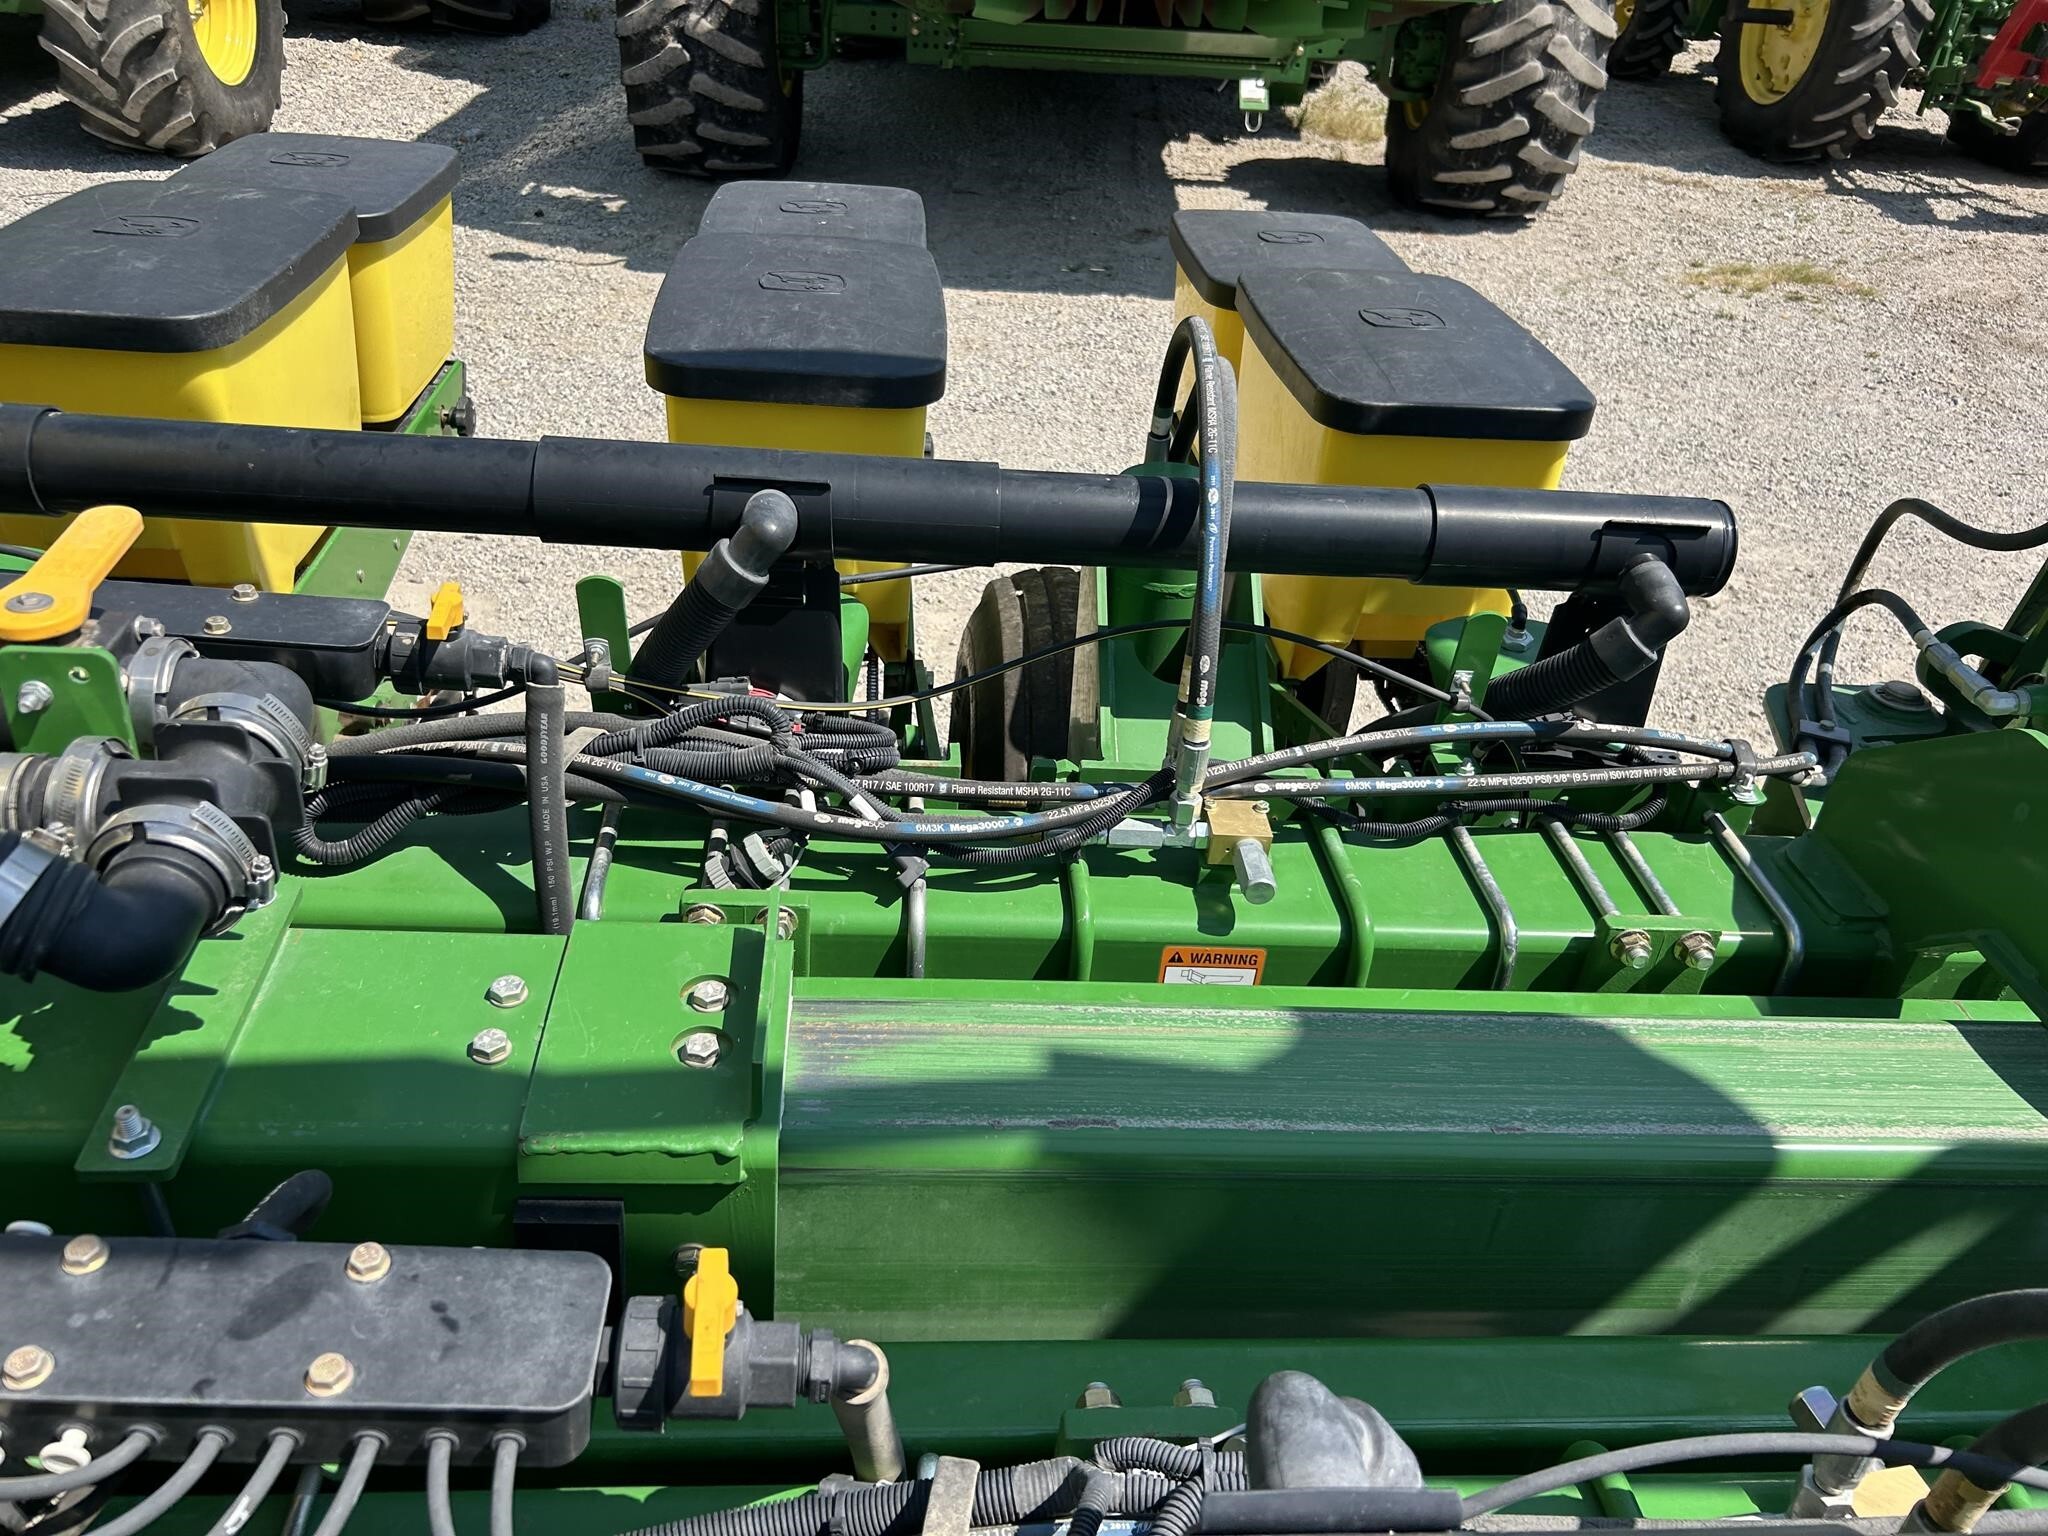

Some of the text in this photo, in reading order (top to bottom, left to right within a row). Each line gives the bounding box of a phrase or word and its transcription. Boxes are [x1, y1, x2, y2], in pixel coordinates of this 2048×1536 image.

[1208, 428, 1218, 454] 2G-11C
[1197, 680, 1209, 707] meg
[540, 712, 549, 764] GOODYEAR
[1228, 761, 1242, 771] R17
[1249, 754, 1264, 767] SAE
[1264, 748, 1291, 763] 100R17
[1304, 742, 1327, 754] Flame
[1326, 735, 1361, 751] Resistant
[1361, 730, 1384, 742] MSHA
[1384, 728, 1412, 739] 2G-11C
[574, 753, 624, 772] SHA 2G-11C
[541, 775, 549, 792] USA
[862, 779, 879, 790] R17
[885, 780, 902, 791] SAE
[904, 782, 935, 793] 100R17
[951, 784, 975, 795] Flame
[977, 785, 1014, 796] Resistant
[1015, 786, 1039, 796] MSHA
[1040, 787, 1071, 797] 2G-11C
[1275, 781, 1318, 792] megasys
[1344, 781, 1372, 791] 6M3K
[1467, 777, 1487, 787] 22.5
[1488, 776, 1509, 787] MPa
[1509, 775, 1533, 787] (3250
[1534, 774, 1552, 785] PSI)
[1572, 773, 1589, 783] (9.5
[1589, 772, 1609, 782] mm)
[1643, 768, 1658, 778] R17
[1663, 767, 1678, 777] SAE
[1718, 764, 1735, 774] Flam
[542, 796, 549, 805] IN
[542, 808, 551, 831] MADE
[915, 823, 945, 833] 6M3K
[1047, 806, 1068, 820] 22.5
[1069, 803, 1091, 817] MPa
[1090, 796, 1115, 812] (3250
[1190, 952, 1259, 966] WARNING
